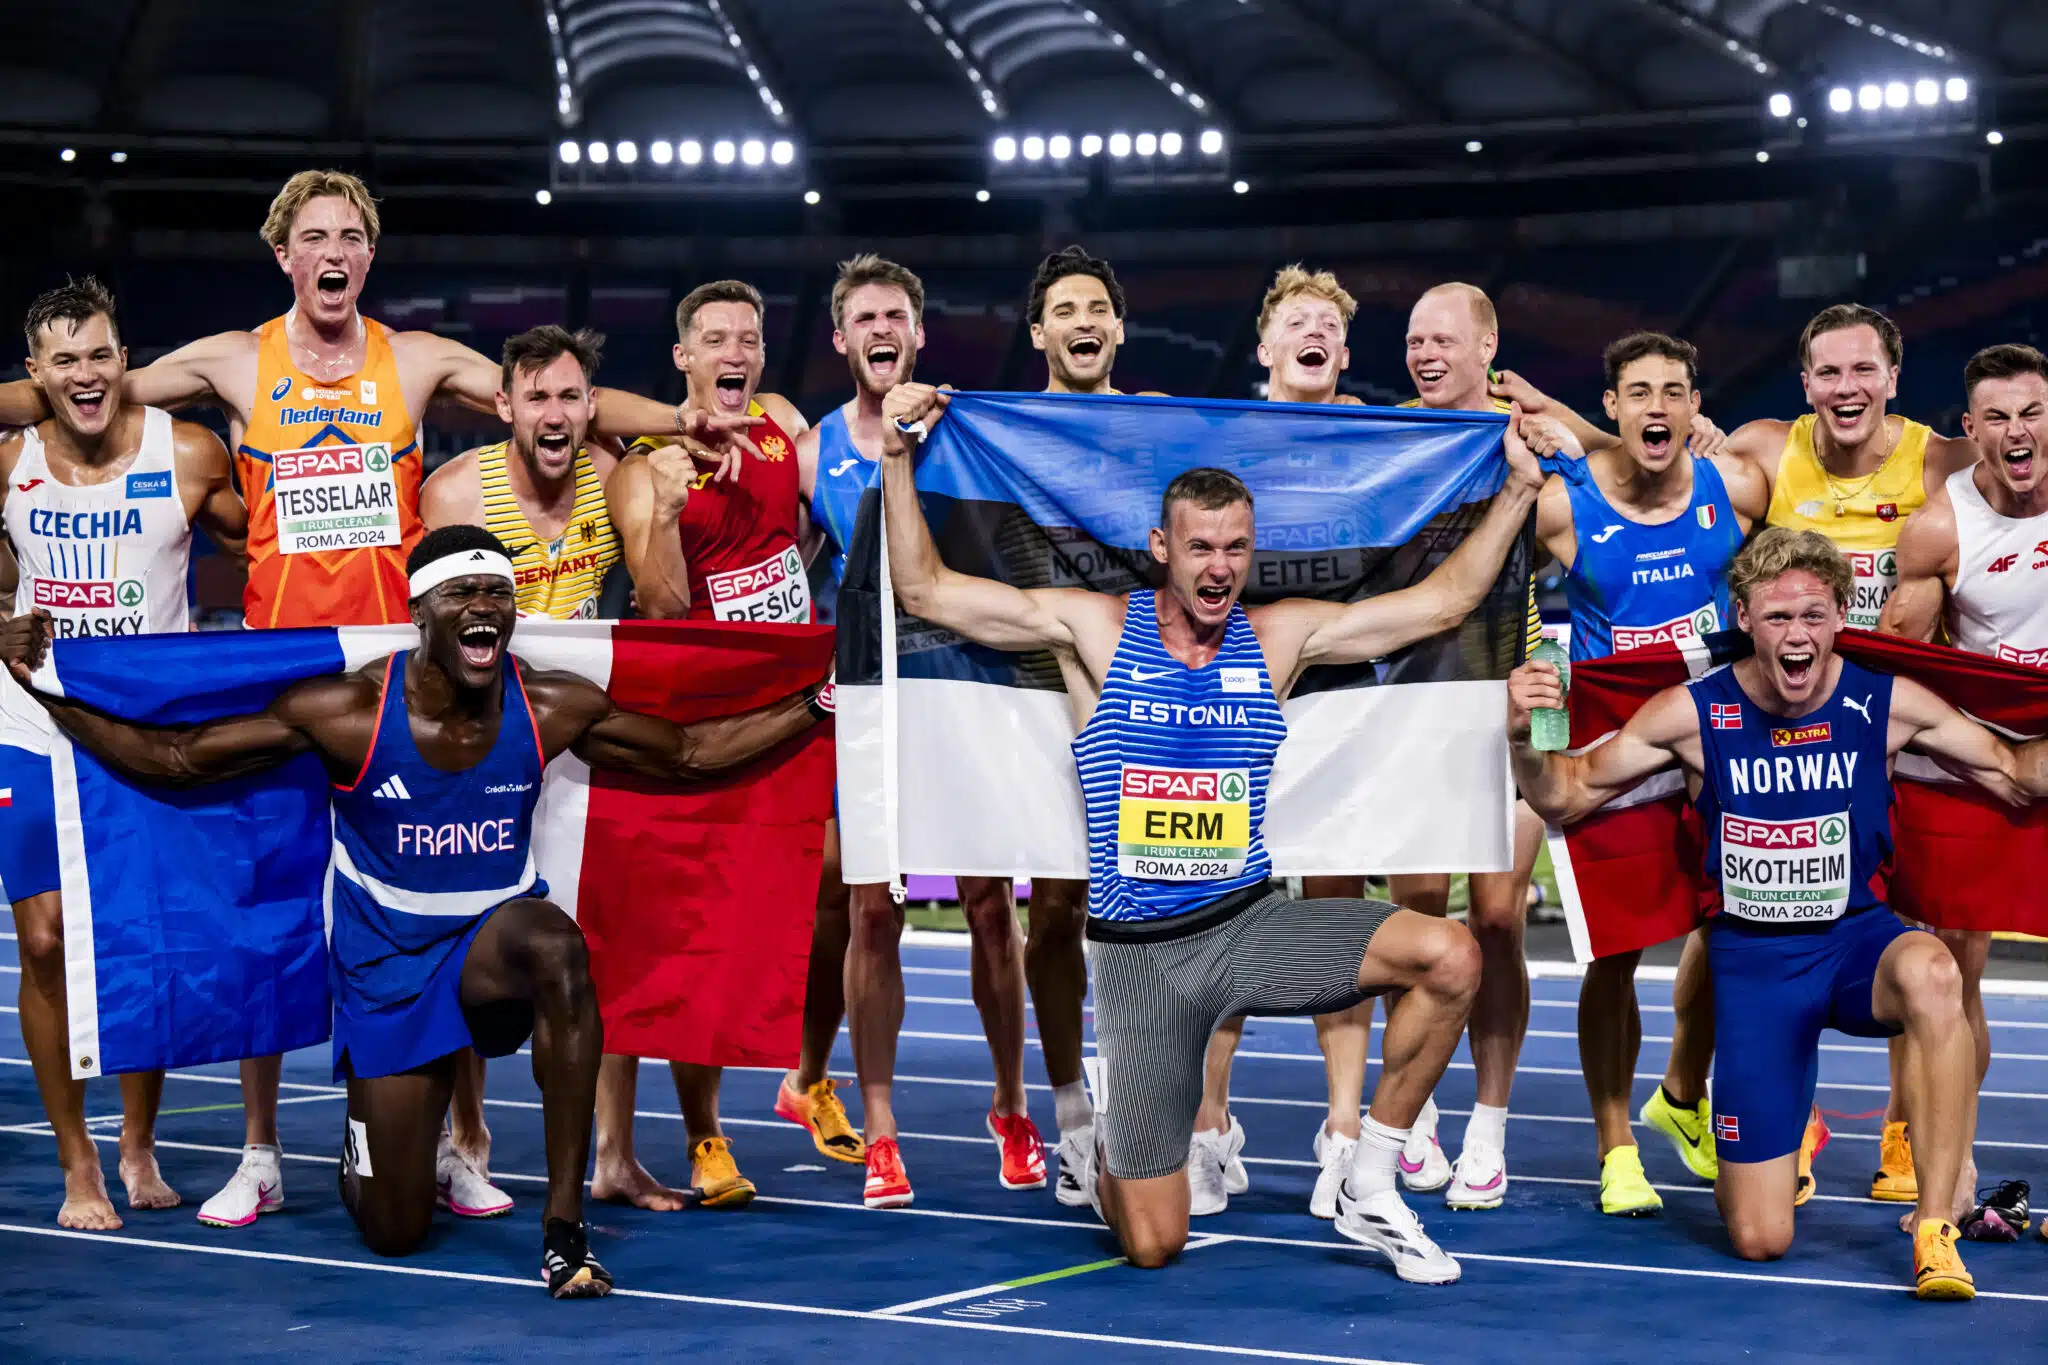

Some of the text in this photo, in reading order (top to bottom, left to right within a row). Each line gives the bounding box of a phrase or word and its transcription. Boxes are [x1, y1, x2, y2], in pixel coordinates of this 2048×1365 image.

[277, 451, 361, 477] SPAR
[277, 482, 393, 516] TESSELAAR
[29, 508, 143, 539] CZECHIA
[308, 521, 333, 531] RUN
[296, 530, 386, 549] ROMA 2024
[1258, 557, 1350, 586] EITEL
[1632, 563, 1695, 585] ITALIA
[1987, 553, 2019, 573] 4F
[713, 560, 784, 599] SPAR
[36, 582, 113, 605] SPAR
[51, 610, 144, 639] TRÁSKÝ
[1615, 621, 1693, 651] SPAR
[1130, 700, 1249, 725] ESTONIA
[1794, 728, 1828, 741] EXTRA
[1125, 773, 1215, 797] SPAR
[1729, 752, 1858, 795] NORWAY
[397, 818, 515, 856] FRANCE
[1145, 810, 1223, 841] ERM
[1726, 821, 1815, 846] SPAR
[1144, 847, 1148, 855] I
[1150, 847, 1176, 857] RUN
[1135, 860, 1228, 876] ROMA 2024
[1725, 853, 1845, 884] SKOTHEIM
[1745, 890, 1749, 899] I
[1751, 891, 1778, 901] RUN
[1738, 902, 1834, 918] ROMA 2024
